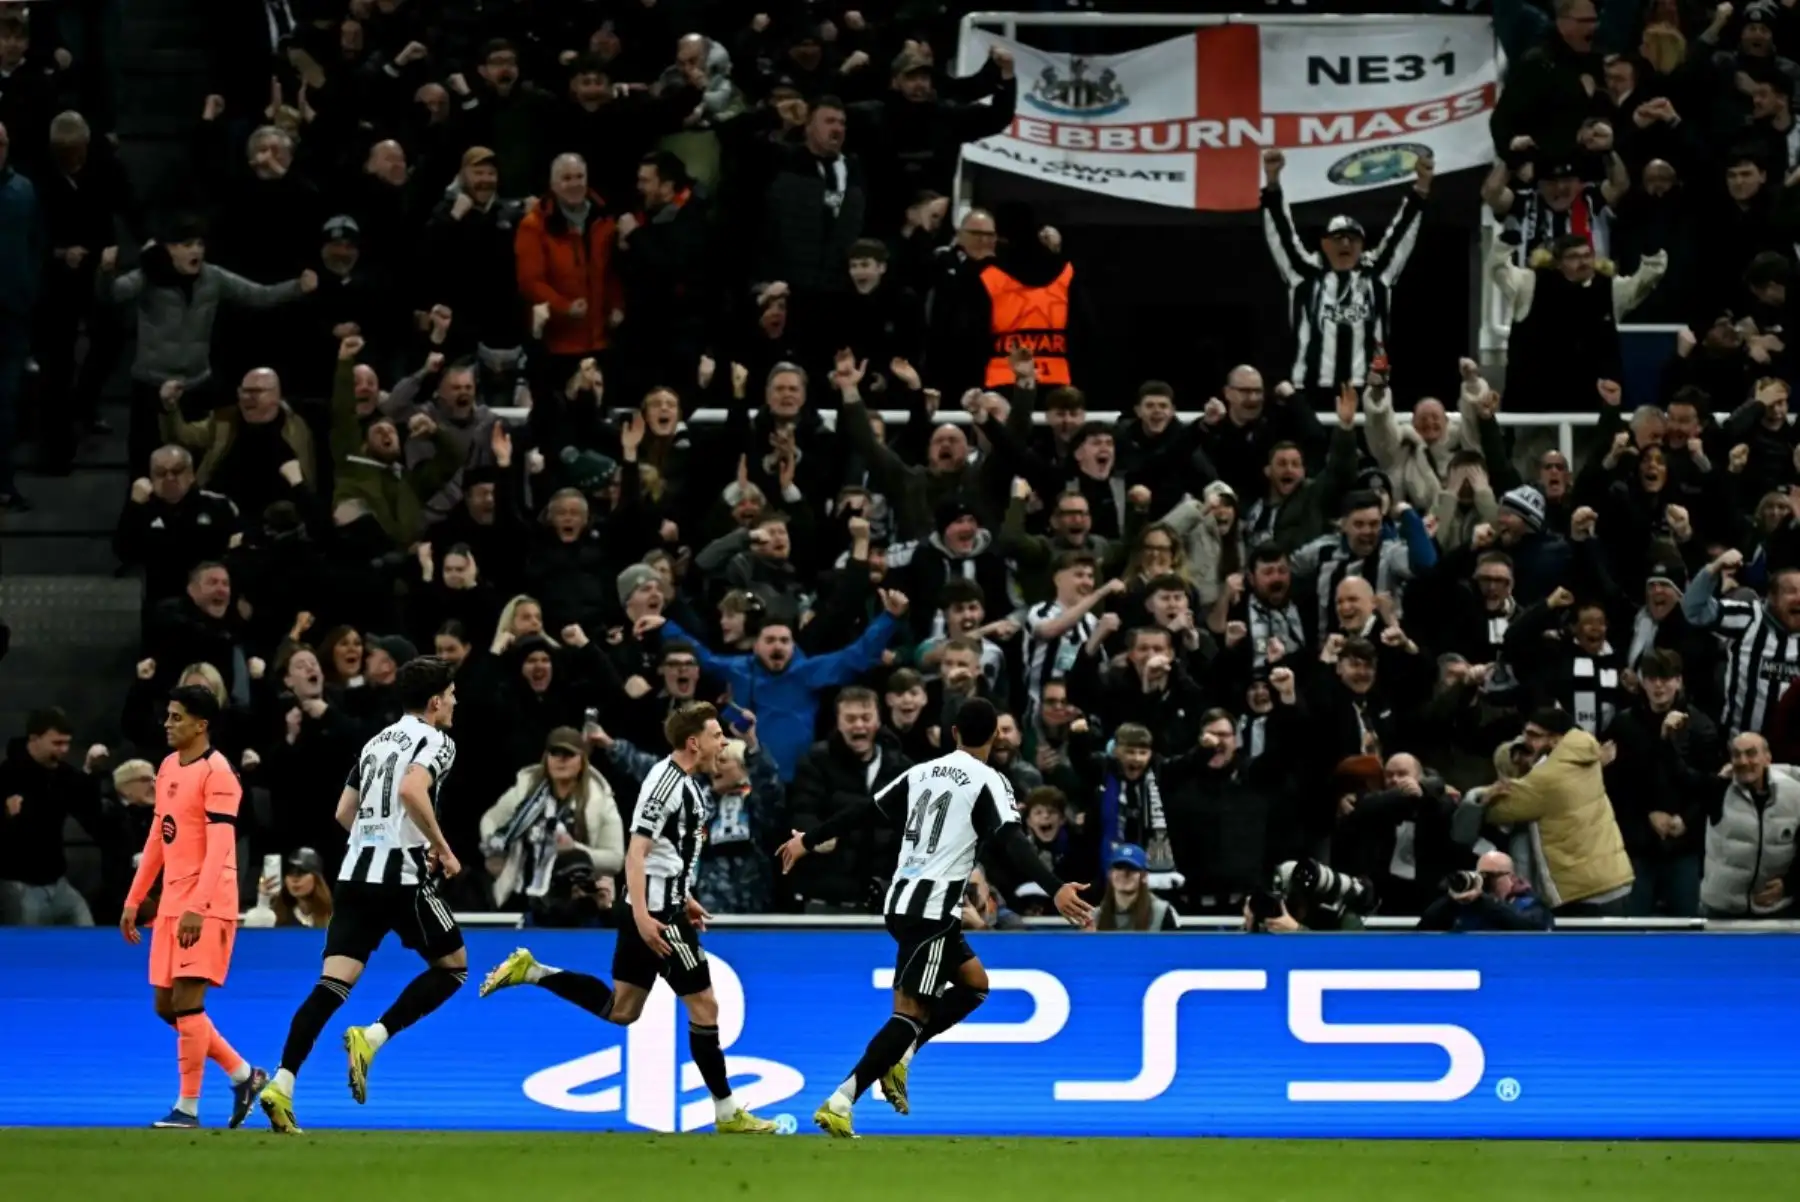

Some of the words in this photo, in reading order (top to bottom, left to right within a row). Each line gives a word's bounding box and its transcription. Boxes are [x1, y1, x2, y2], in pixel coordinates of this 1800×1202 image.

[1307, 51, 1456, 85] NE31
[1003, 116, 1275, 151] EBBURN
[1298, 87, 1486, 145] MAGS
[360, 751, 399, 818] 21
[931, 765, 971, 787] RAMSEY
[904, 788, 953, 854] 41
[872, 968, 1486, 1101] PS5
